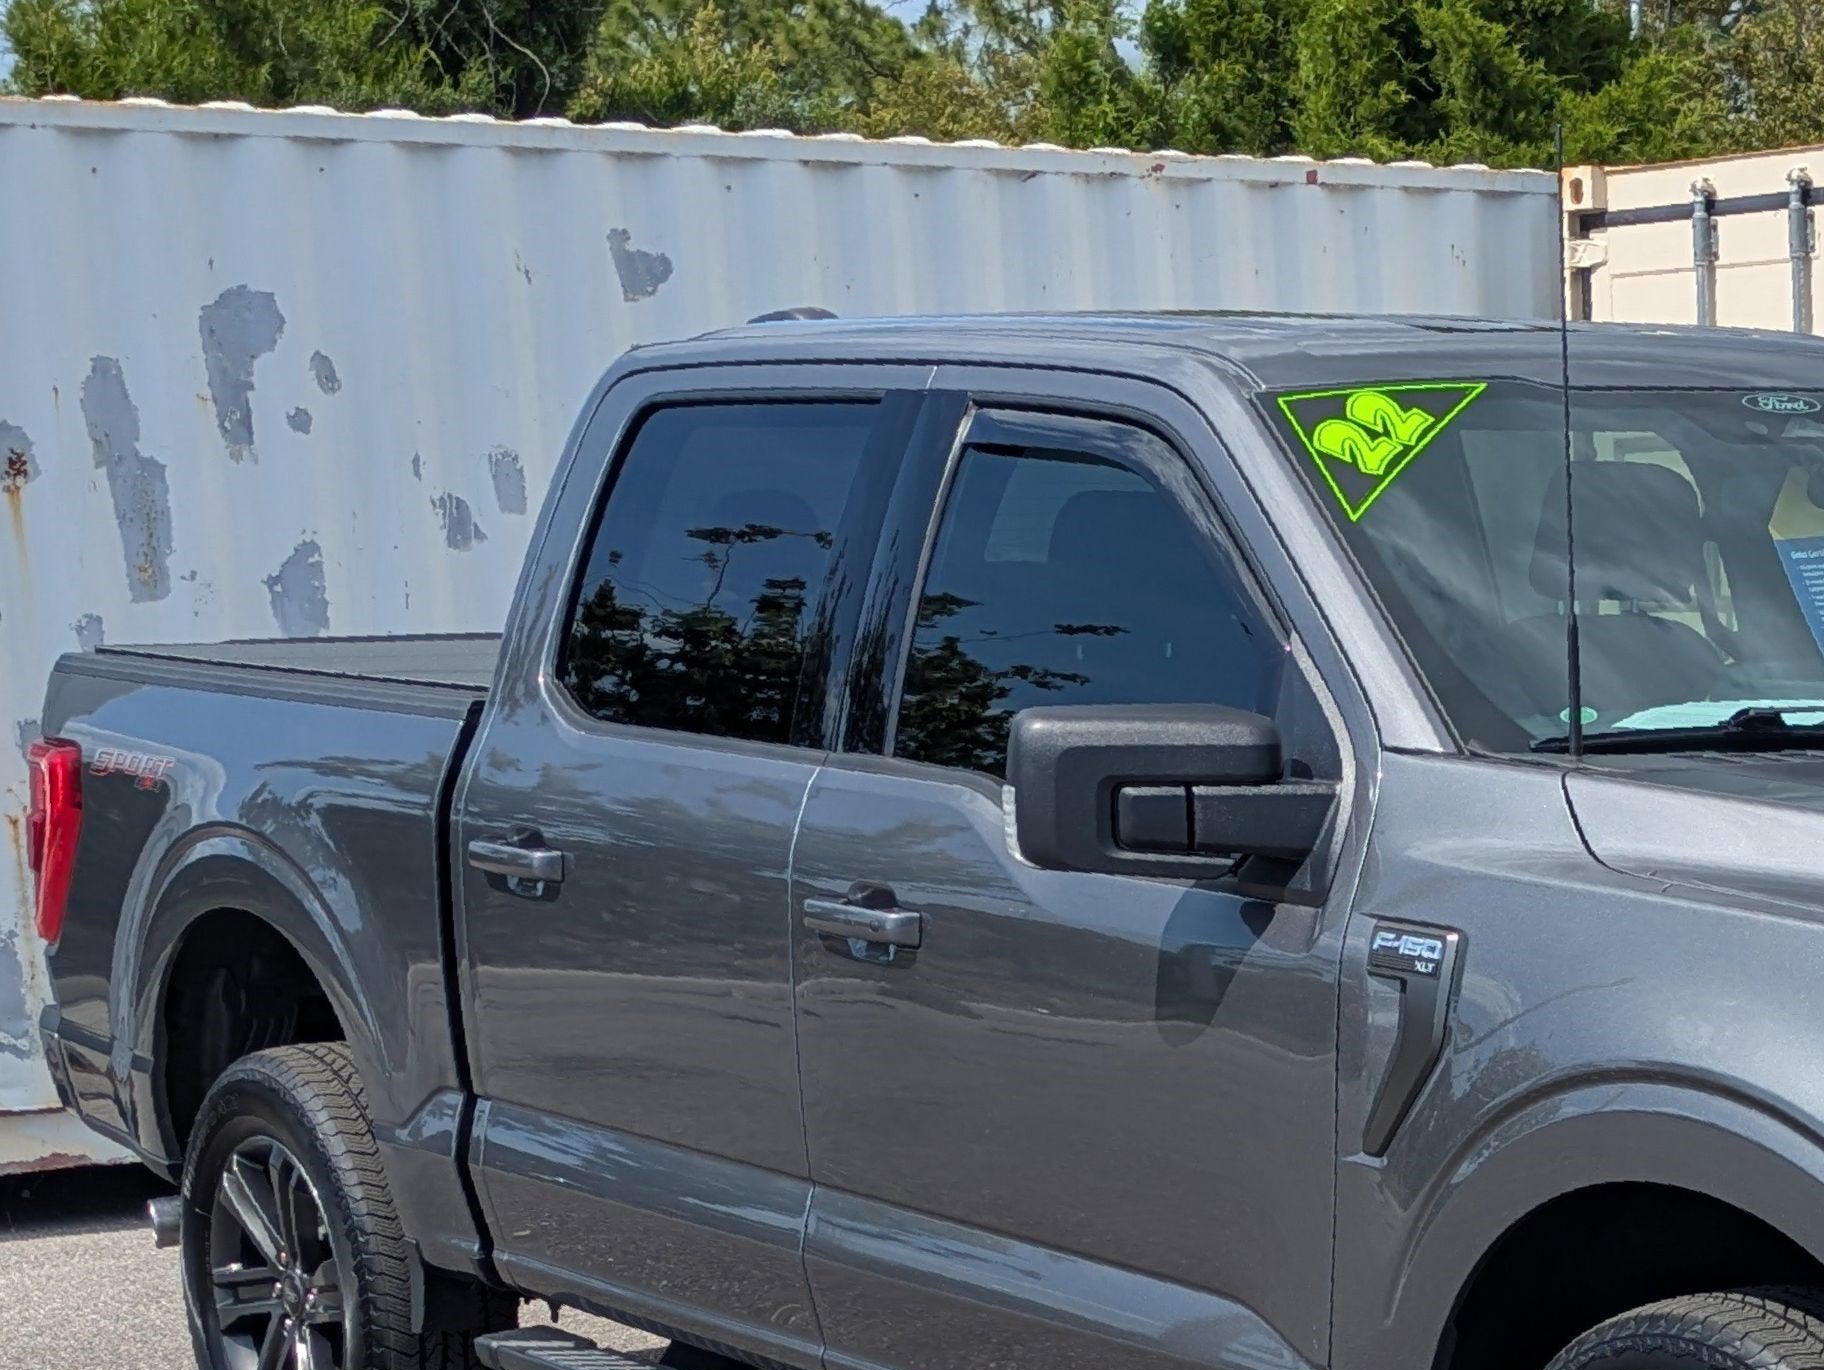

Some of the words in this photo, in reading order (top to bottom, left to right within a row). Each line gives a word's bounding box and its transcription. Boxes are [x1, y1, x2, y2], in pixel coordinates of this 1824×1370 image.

[1758, 393, 1809, 410] Ford
[1313, 391, 1435, 475] 22
[90, 748, 176, 777] SPORT
[1373, 931, 1442, 959] F-150
[1413, 960, 1436, 974] XLT
